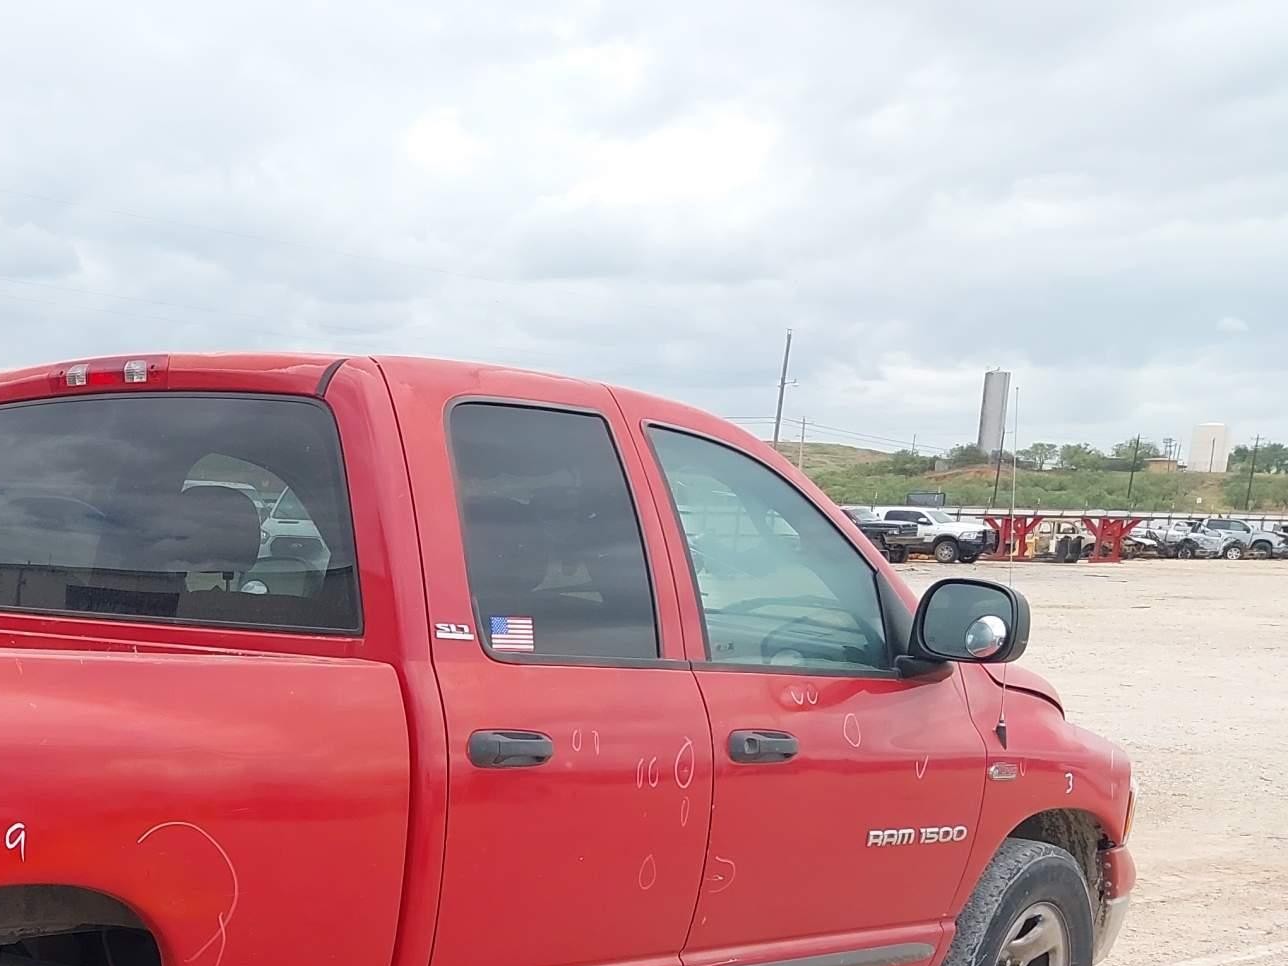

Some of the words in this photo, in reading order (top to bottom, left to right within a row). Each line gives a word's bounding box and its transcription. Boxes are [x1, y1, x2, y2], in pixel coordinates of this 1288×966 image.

[1063, 772, 1073, 794] 3
[5, 822, 26, 863] 9
[866, 828, 915, 848] RAM
[919, 825, 968, 844] 1500
